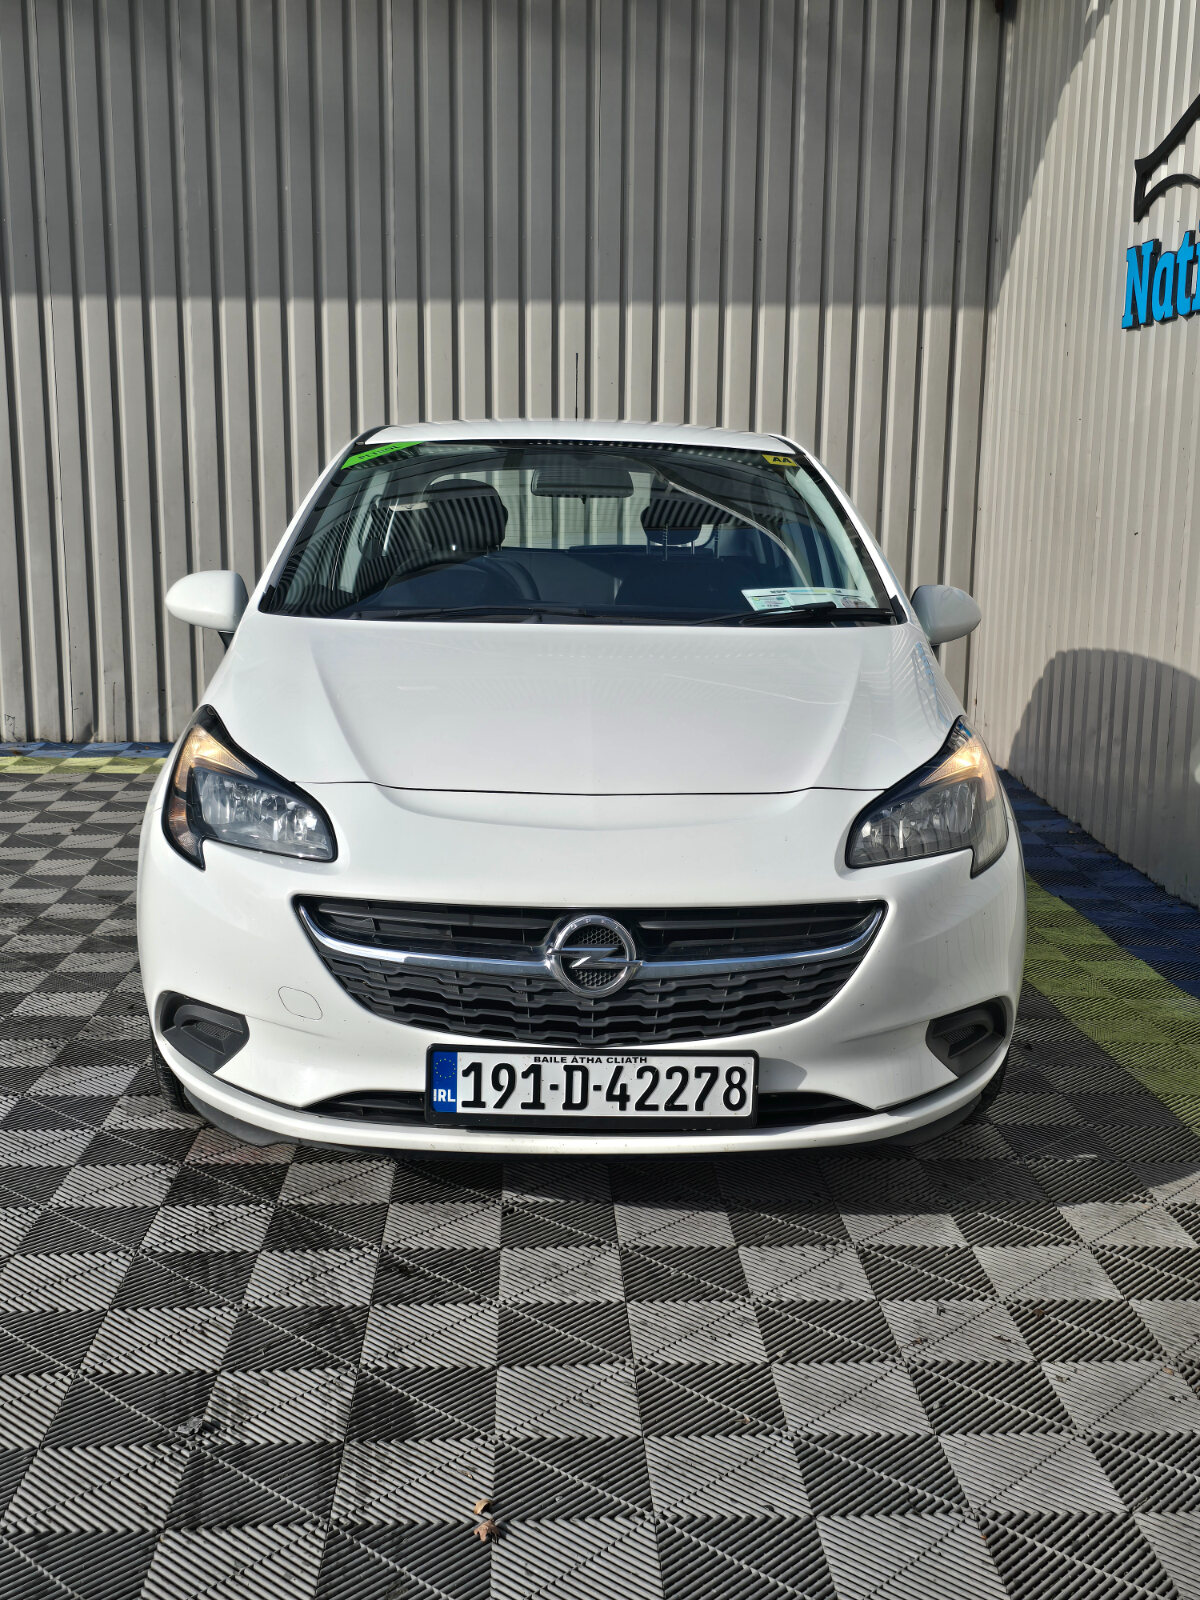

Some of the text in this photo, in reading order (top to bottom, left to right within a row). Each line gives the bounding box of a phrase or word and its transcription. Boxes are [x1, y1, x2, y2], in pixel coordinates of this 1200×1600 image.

[533, 1056, 567, 1064] BAILE
[571, 1055, 602, 1064] ÁTHA
[461, 1062, 747, 1112] 191-D-42278
[433, 1088, 456, 1103] IRL
